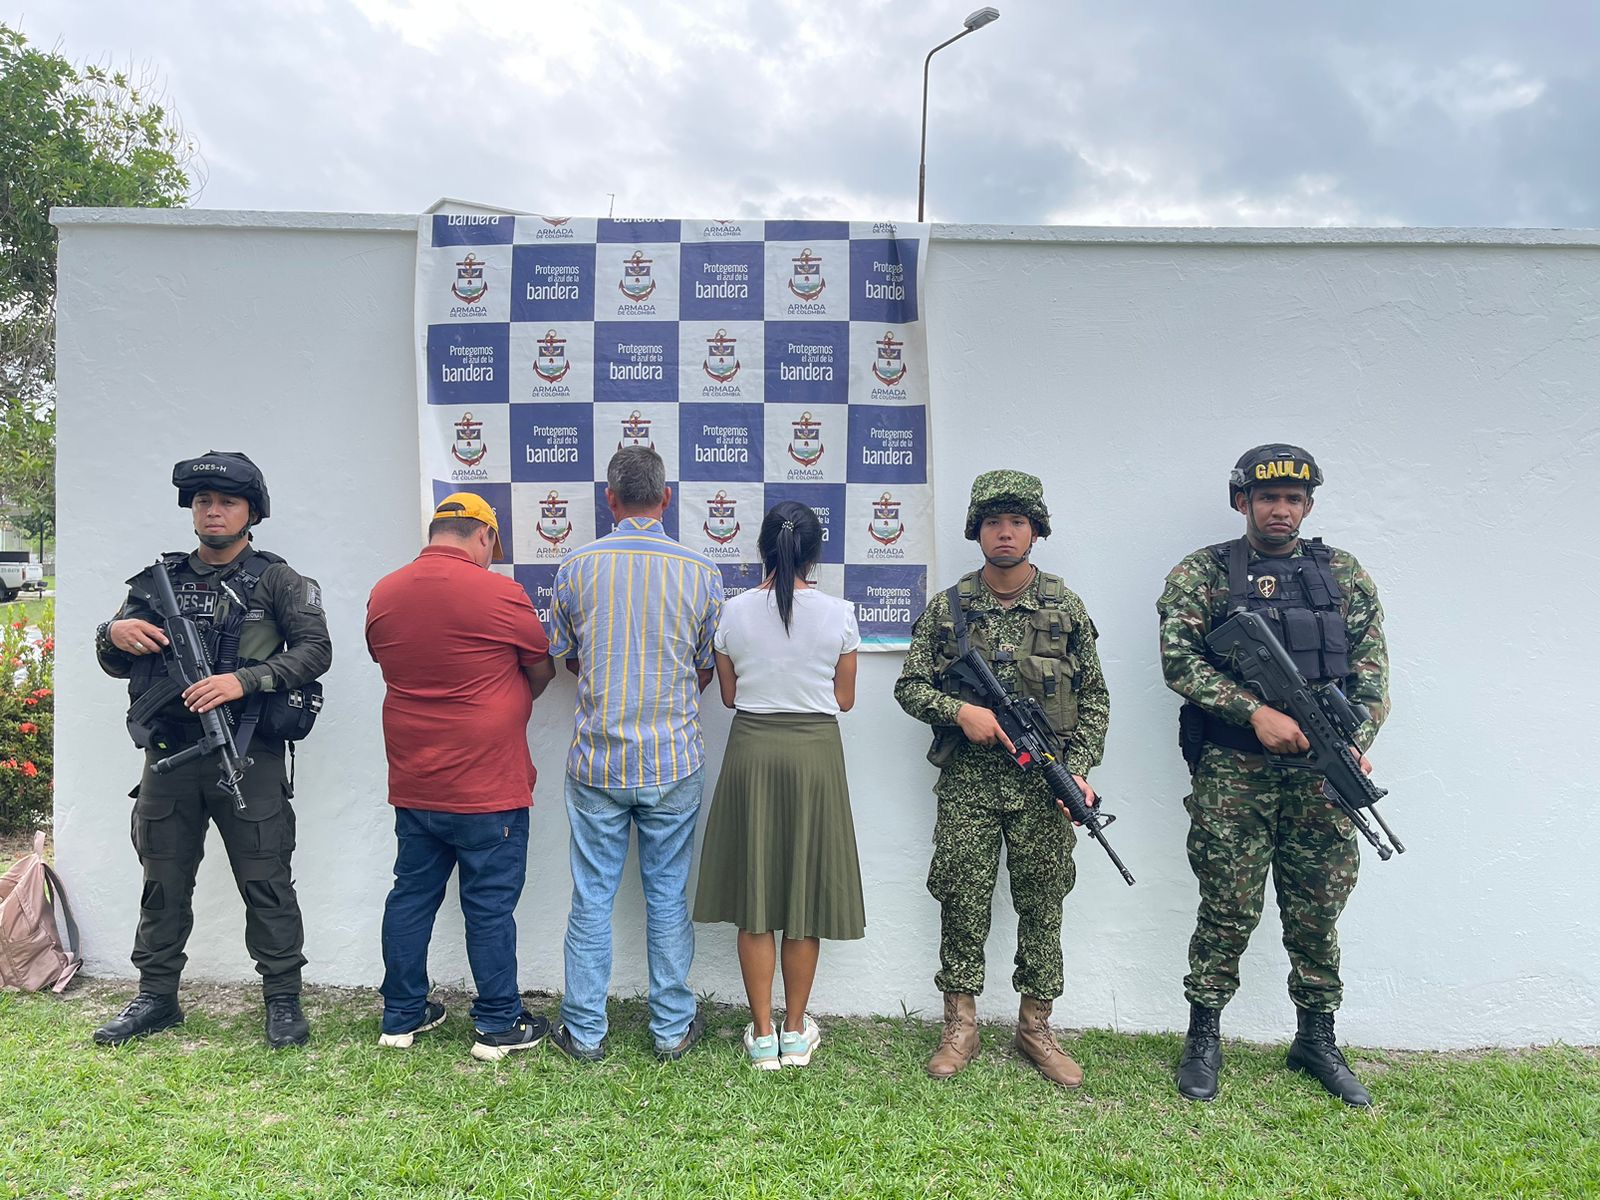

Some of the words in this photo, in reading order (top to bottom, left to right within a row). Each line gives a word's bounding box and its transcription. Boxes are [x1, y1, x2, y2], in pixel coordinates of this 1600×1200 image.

[535, 265, 579, 276] Protegemos
[704, 263, 748, 274] Protegemos
[527, 282, 578, 300] bandera
[696, 280, 748, 298] bandera
[450, 346, 493, 357] Protegemos
[618, 344, 662, 355] Protegemos
[788, 344, 833, 355] Protegemos
[463, 356, 468, 364] el
[468, 356, 480, 364] azul
[481, 356, 487, 364] de
[488, 356, 493, 364] la
[802, 355, 806, 363] el
[808, 355, 819, 363] azul
[820, 355, 827, 363] de
[828, 355, 833, 363] la
[442, 364, 493, 382] bandera
[610, 361, 662, 380] bandera
[781, 362, 833, 381] bandera
[534, 426, 577, 437] Protegemos
[703, 425, 748, 437] Protegemos
[871, 428, 912, 439] Protegemos
[716, 436, 722, 444] el
[722, 436, 734, 444] azul
[735, 436, 742, 444] de
[743, 436, 748, 444] la
[882, 439, 887, 447] el
[888, 439, 899, 447] azul
[900, 439, 907, 447] de
[908, 439, 912, 447] la
[527, 444, 578, 463] bandera
[695, 444, 748, 462] bandera
[863, 446, 912, 465] bandera
[192, 463, 227, 472] GOES-H
[1255, 460, 1310, 480] GAULA
[867, 586, 910, 597] Protegemos
[859, 604, 910, 622] bandera
